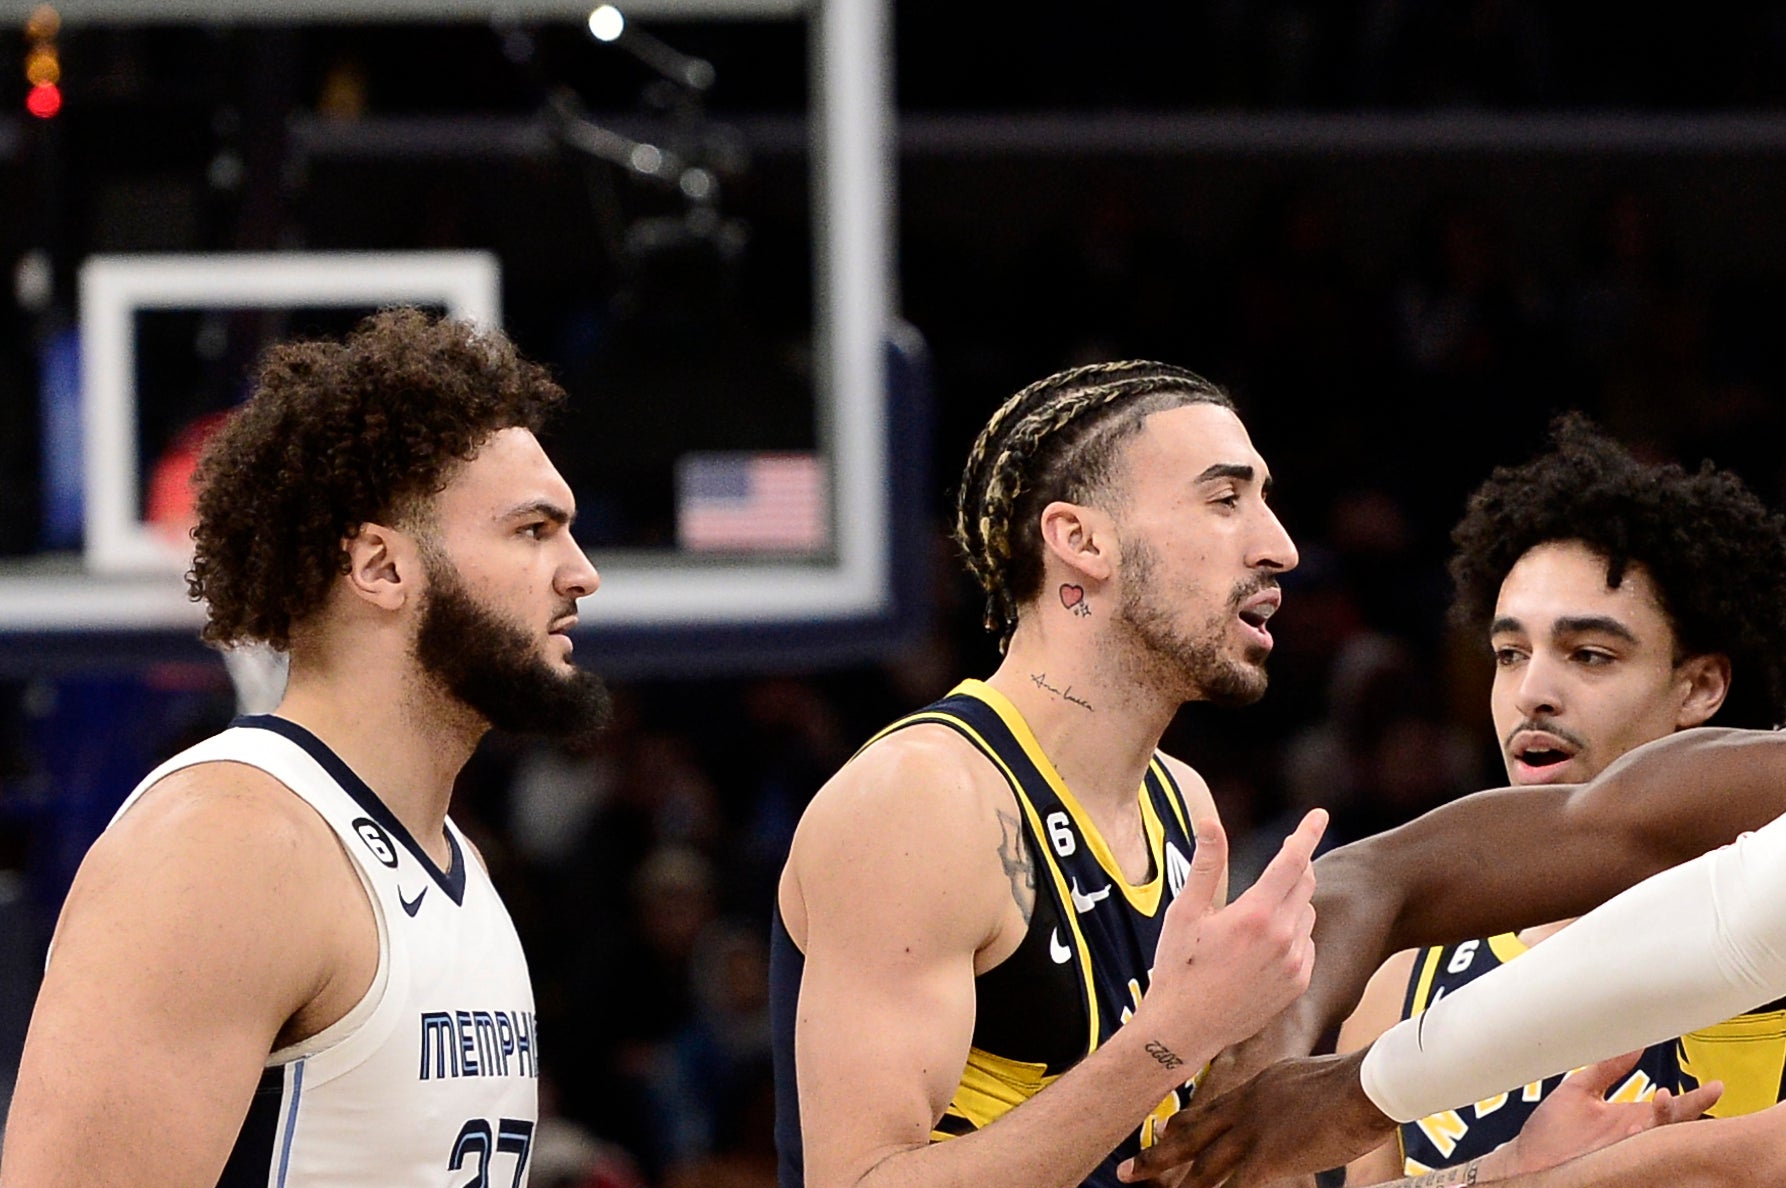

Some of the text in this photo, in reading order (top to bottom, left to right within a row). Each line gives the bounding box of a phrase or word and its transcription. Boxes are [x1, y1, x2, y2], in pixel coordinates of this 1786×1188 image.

[358, 824, 394, 863] 6
[1046, 811, 1076, 857] 6
[1447, 939, 1480, 974] 6
[419, 1010, 539, 1080] MEMPHI
